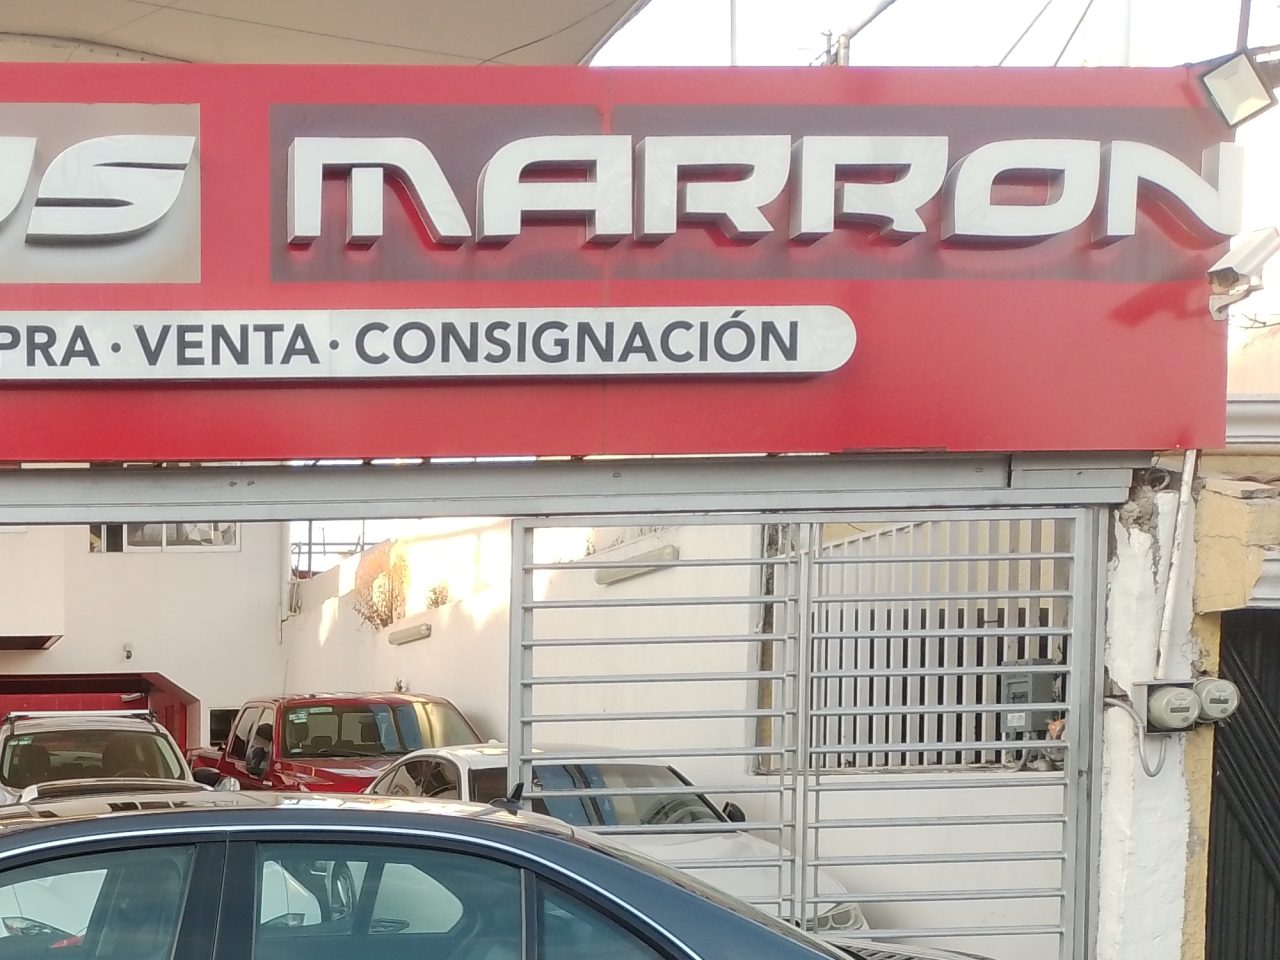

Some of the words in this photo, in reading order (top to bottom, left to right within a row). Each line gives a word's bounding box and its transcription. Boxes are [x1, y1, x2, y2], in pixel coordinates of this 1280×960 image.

[288, 134, 1242, 246] MARRON
[134, 319, 320, 367] VENTA
[356, 308, 801, 364] CONSIGNACIÓN
